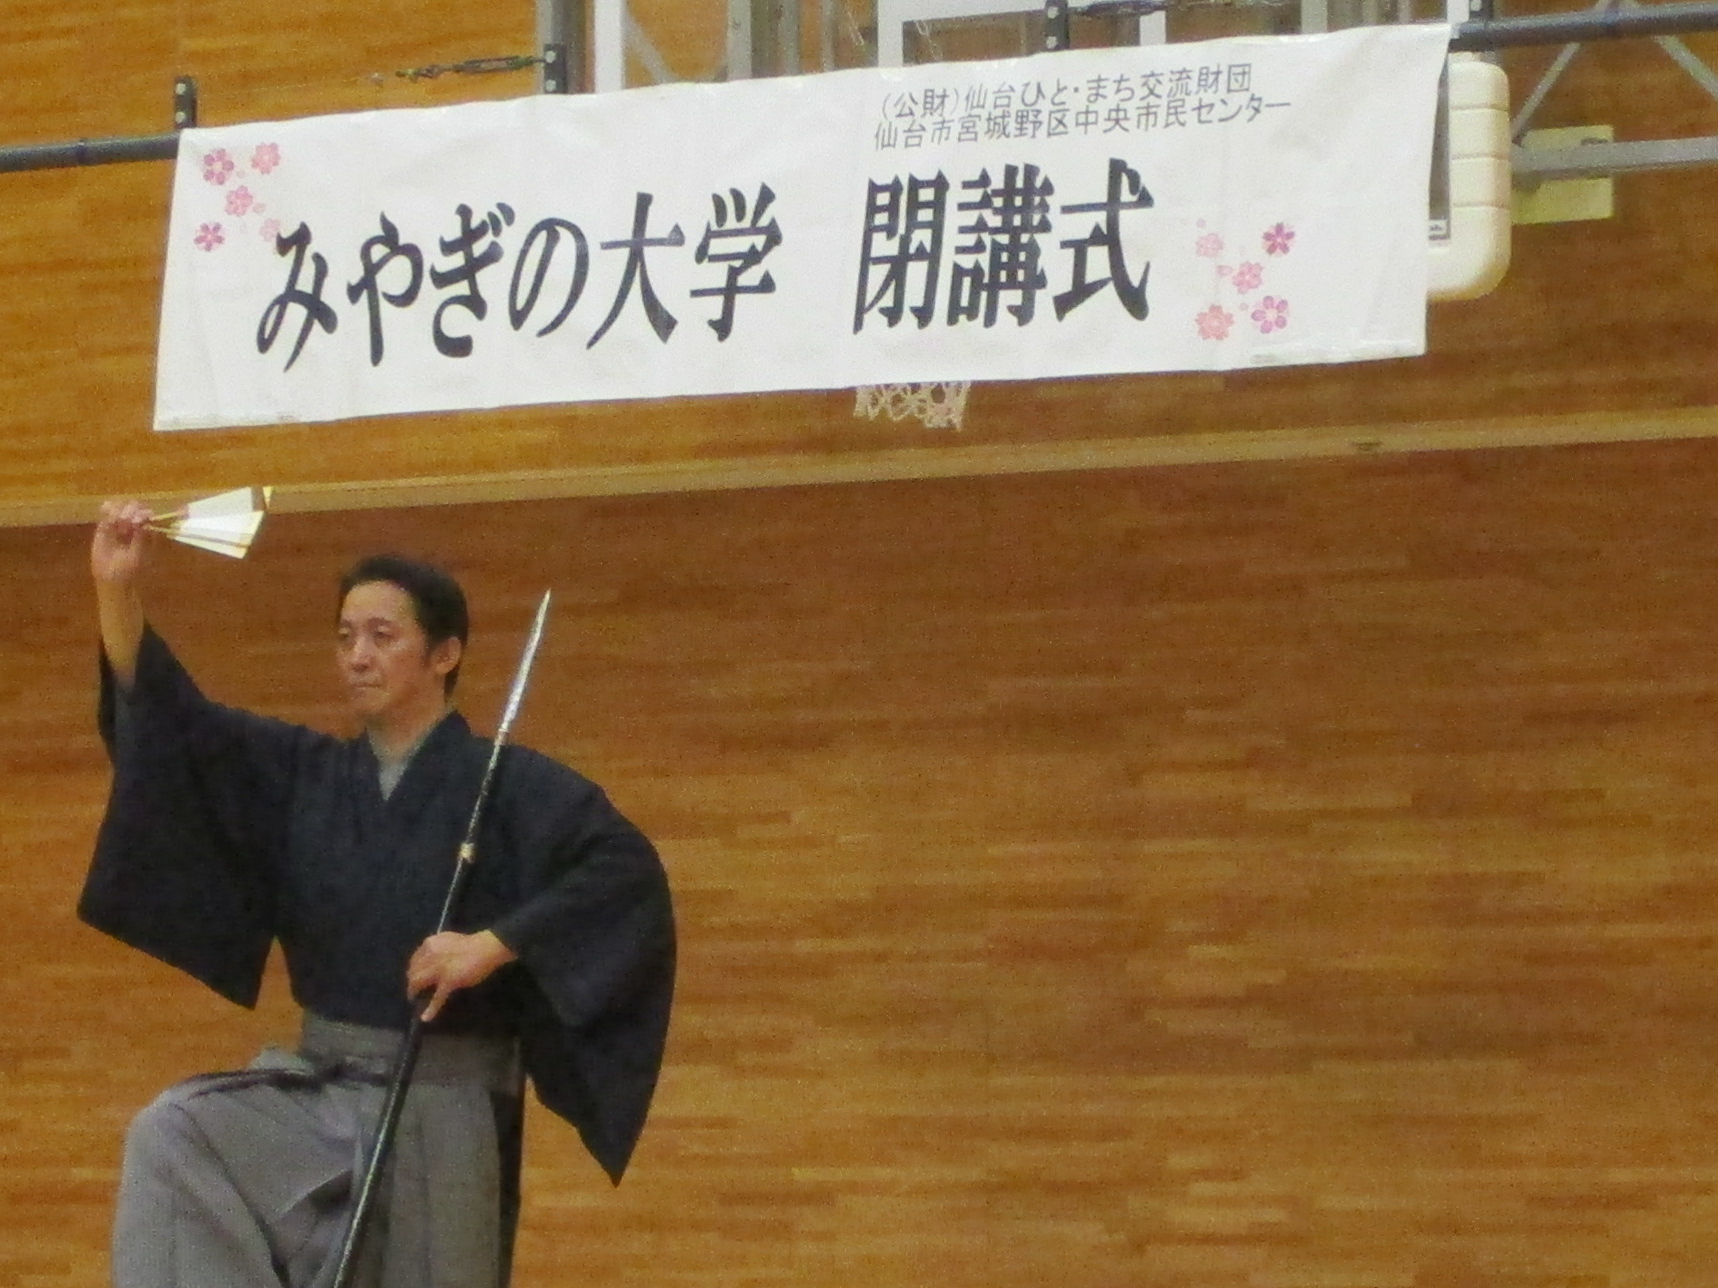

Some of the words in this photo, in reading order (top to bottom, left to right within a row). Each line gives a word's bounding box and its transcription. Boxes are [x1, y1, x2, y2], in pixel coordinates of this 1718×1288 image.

[874, 93, 1291, 150] 仙台市宮城野区中央市民センター
[256, 183, 783, 371] みやぎの大学
[853, 158, 1154, 335] 閉講式
